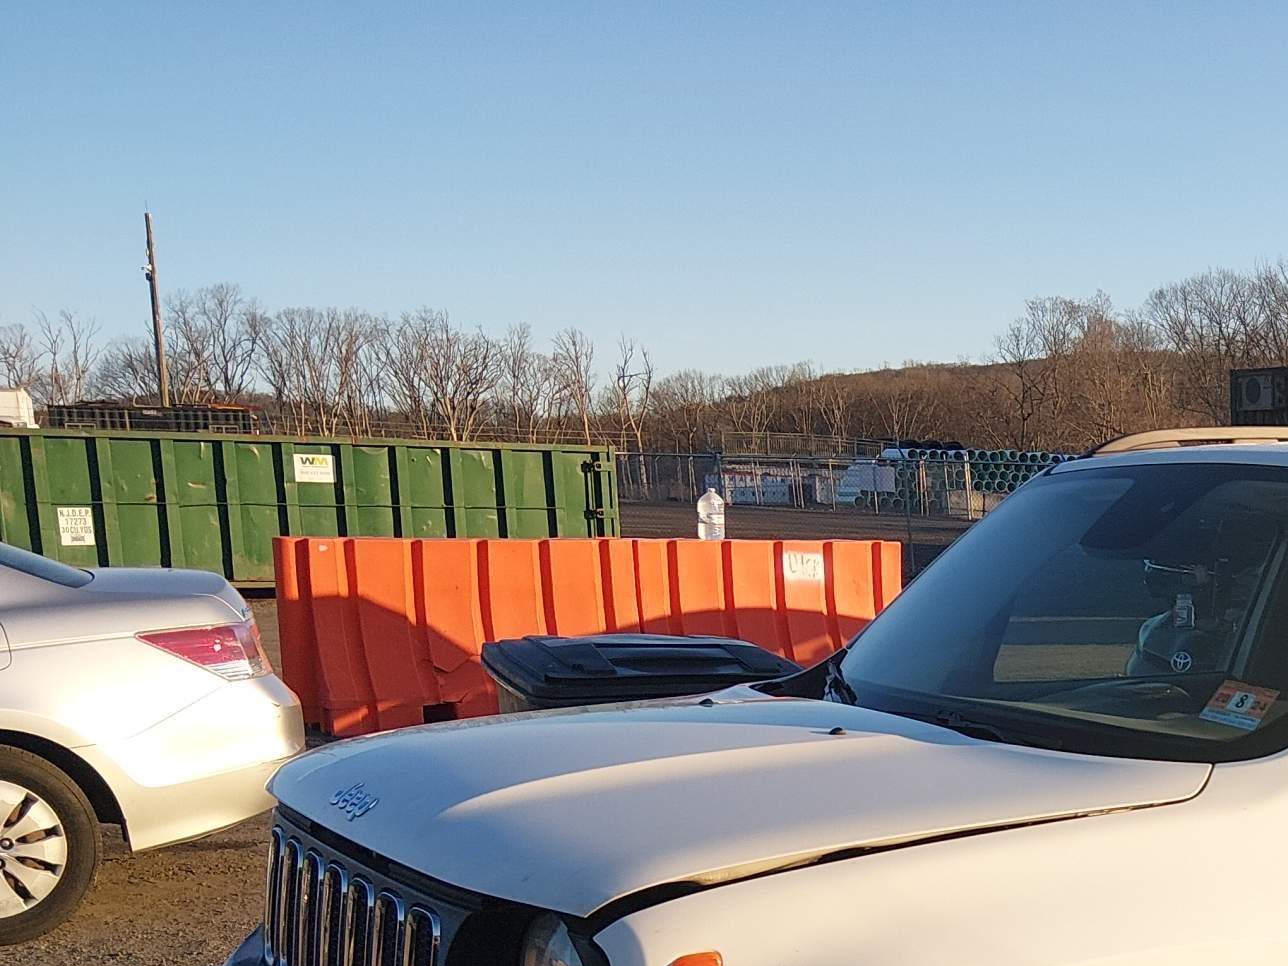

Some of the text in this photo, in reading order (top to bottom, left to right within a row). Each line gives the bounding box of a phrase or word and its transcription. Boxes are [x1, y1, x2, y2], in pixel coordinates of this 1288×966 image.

[300, 456, 328, 465] WM
[1235, 695, 1248, 708] 8
[328, 783, 379, 822] Jeep
